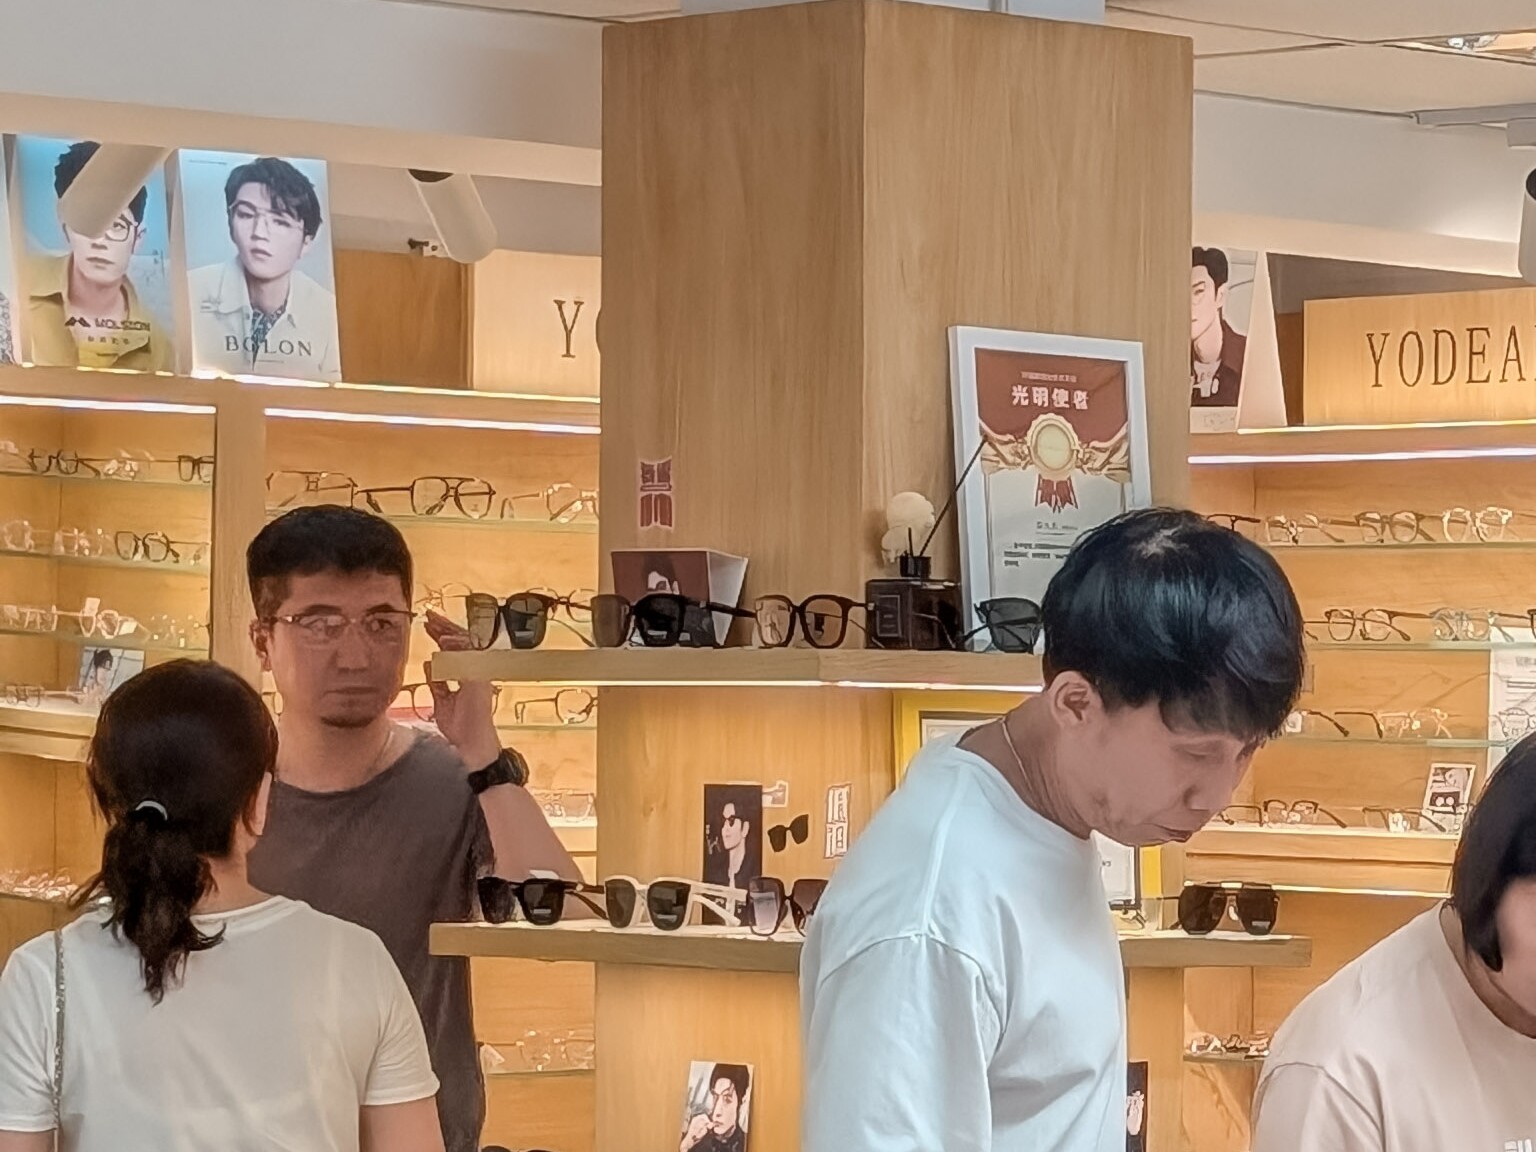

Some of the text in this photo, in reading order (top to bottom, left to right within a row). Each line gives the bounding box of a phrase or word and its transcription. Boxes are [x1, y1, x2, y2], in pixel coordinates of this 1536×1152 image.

[553, 299, 601, 358] Y
[225, 335, 312, 356] BOLON
[1012, 385, 1089, 410] 光明使者
